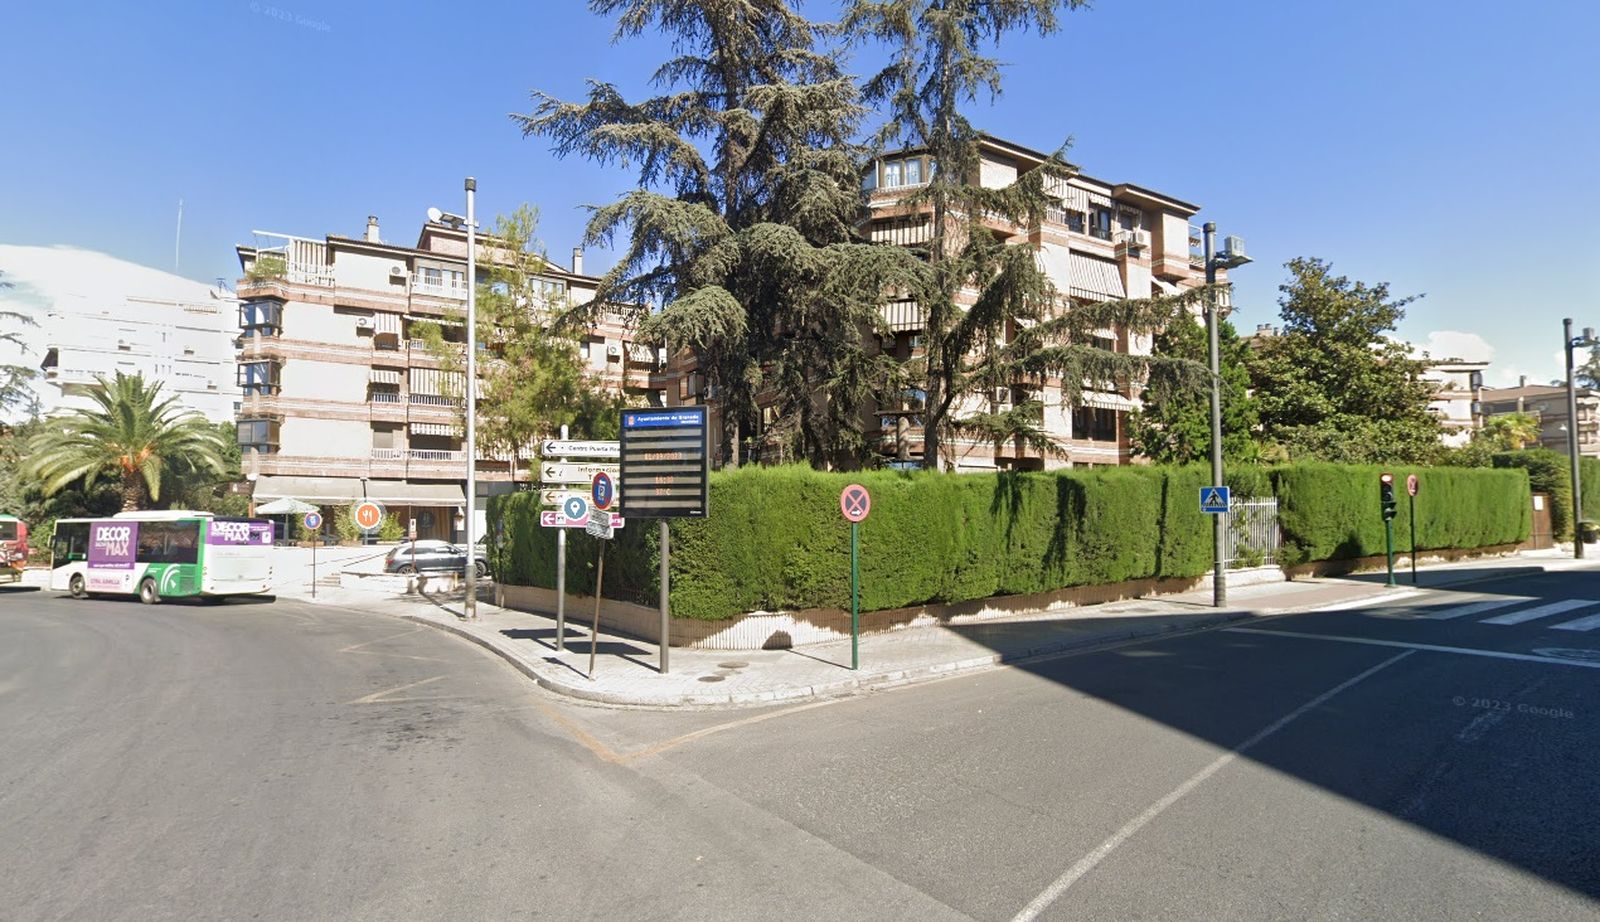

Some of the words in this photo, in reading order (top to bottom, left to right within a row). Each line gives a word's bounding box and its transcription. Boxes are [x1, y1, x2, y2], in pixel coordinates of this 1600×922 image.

[96, 526, 131, 541] DECOR
[211, 522, 250, 533] DECOR
[224, 531, 250, 541] MAX
[105, 542, 129, 556] MAX
